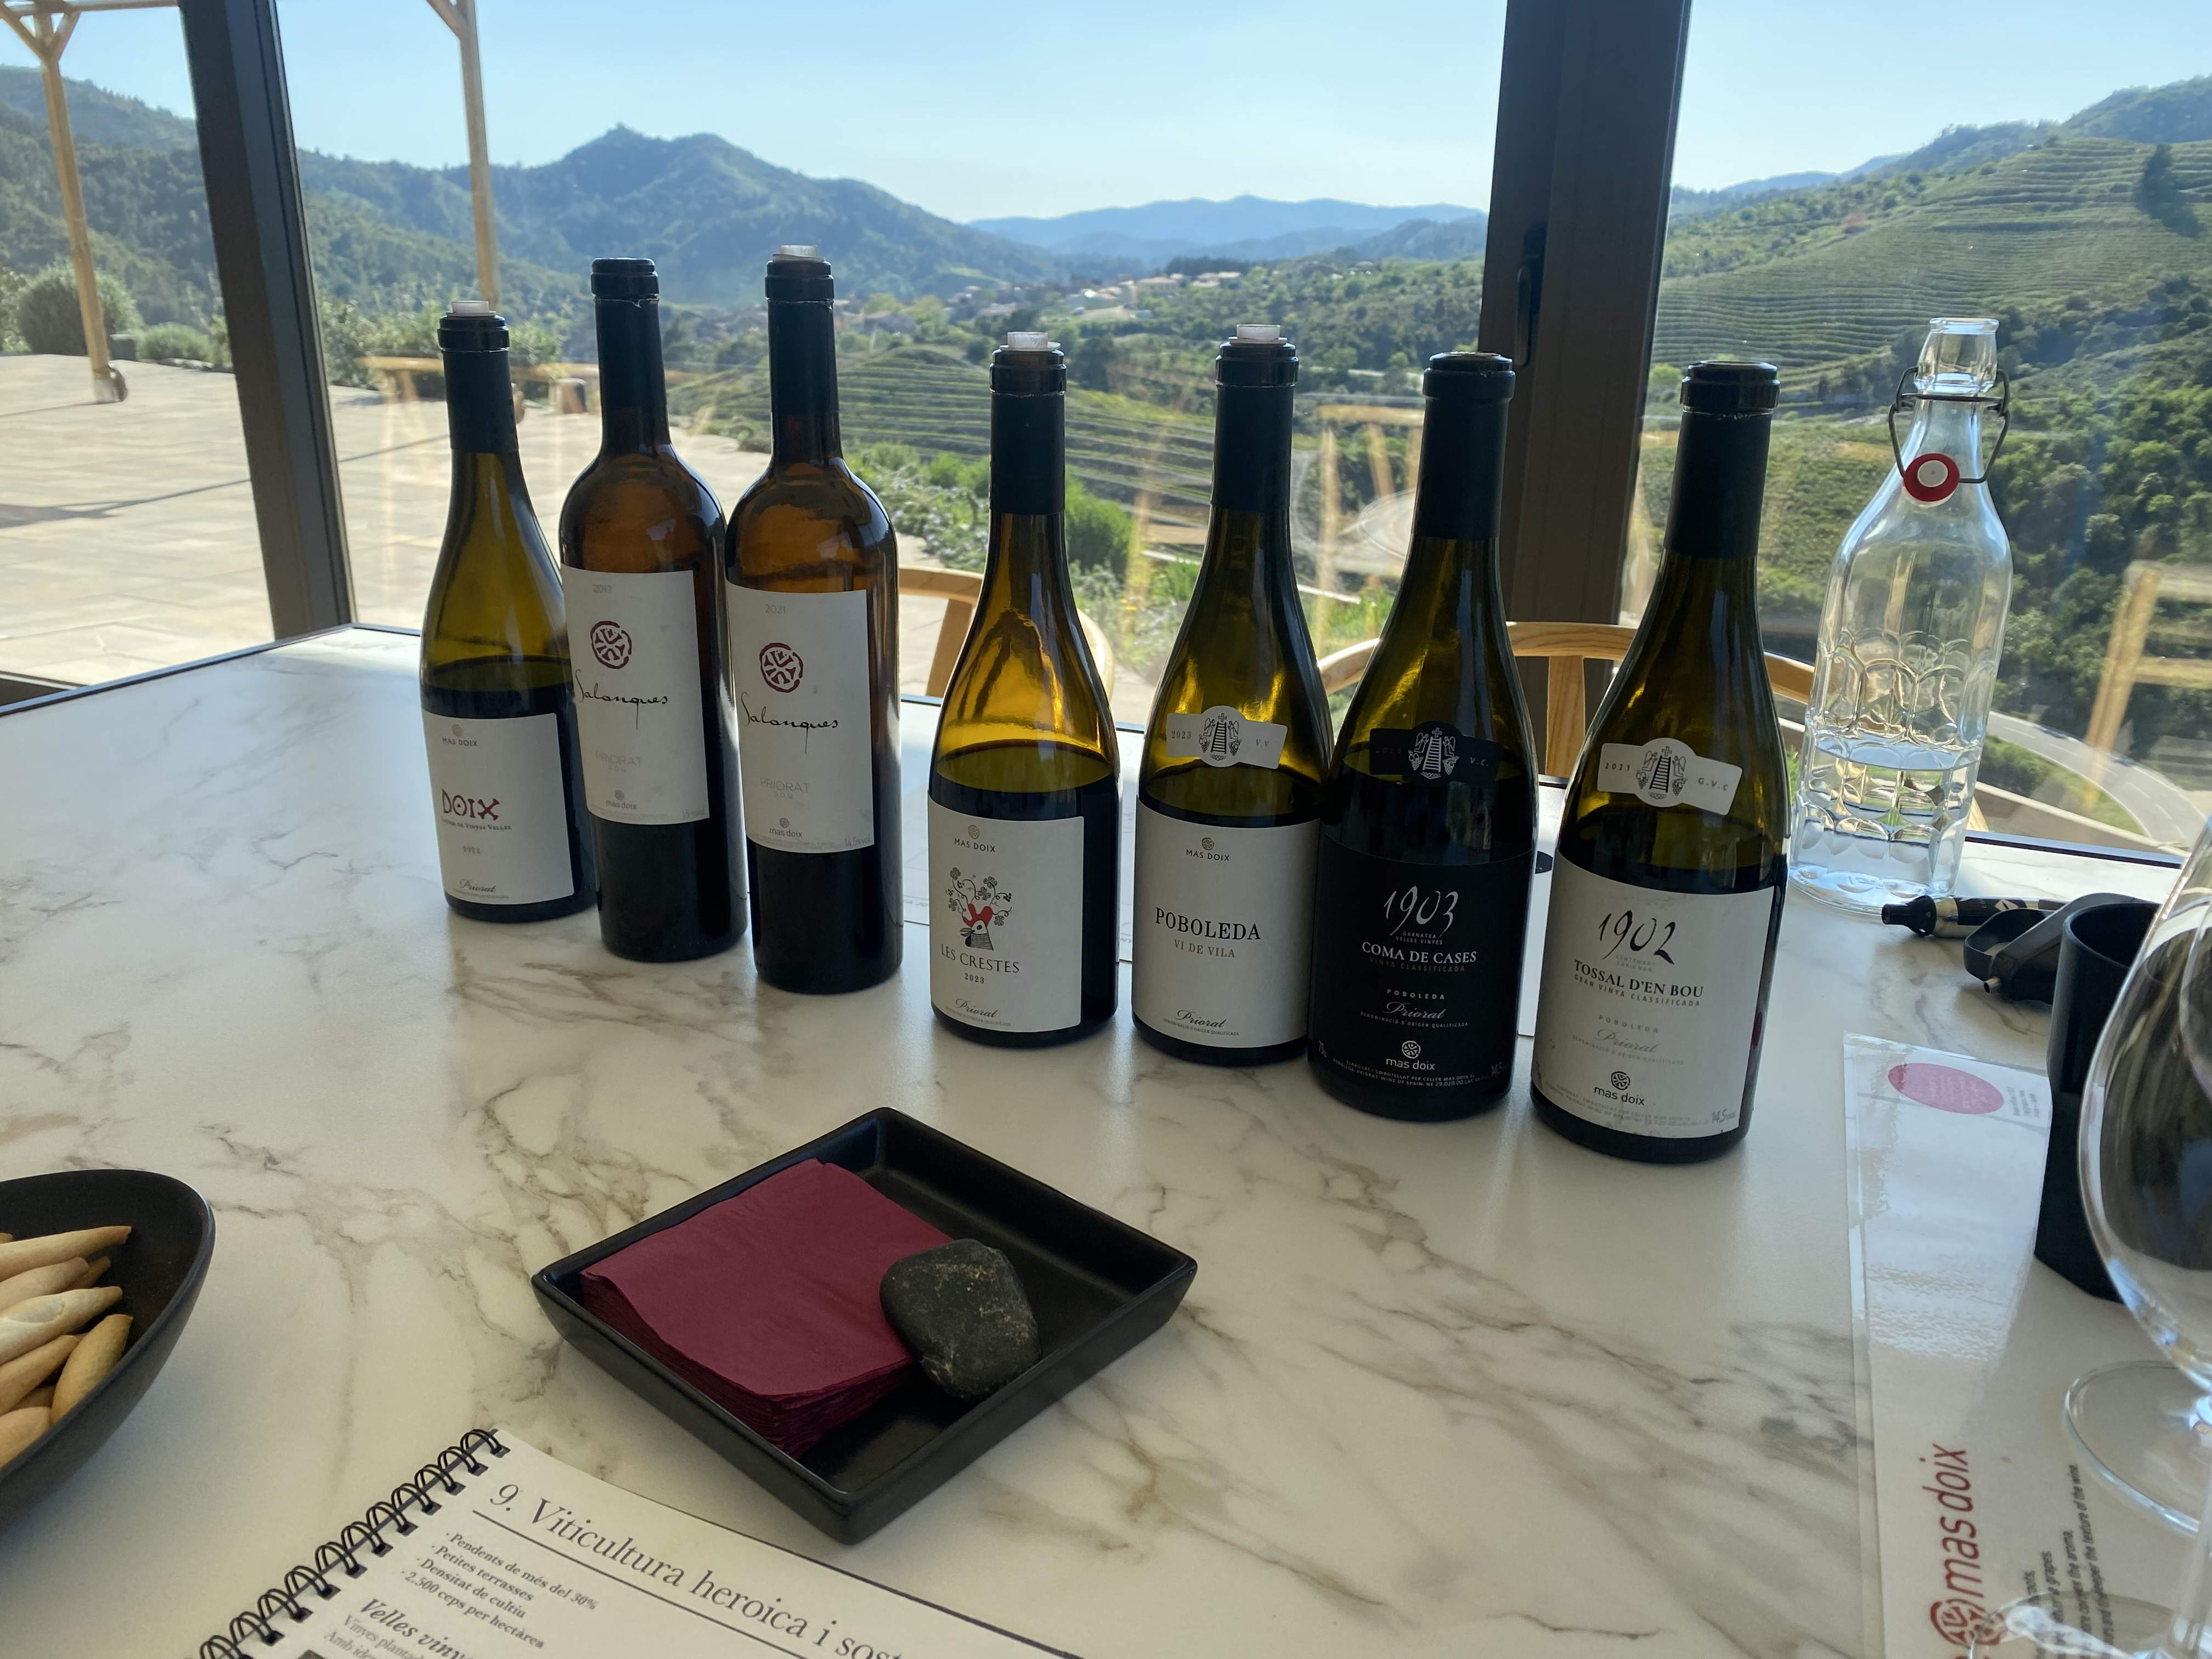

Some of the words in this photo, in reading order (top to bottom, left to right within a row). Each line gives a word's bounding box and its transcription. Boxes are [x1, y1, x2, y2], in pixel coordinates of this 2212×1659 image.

[765, 604, 786, 614] 2021
[575, 669, 668, 729] Salanques
[740, 692, 838, 755] Salanques
[442, 736, 456, 744] MAS
[1171, 731, 1191, 740] 2023
[1604, 763, 1630, 771] 2021
[441, 788, 500, 821] DOIX
[606, 800, 620, 808] mas
[769, 827, 785, 836] mas
[786, 828, 803, 838] doix
[954, 838, 970, 848] MAS
[974, 843, 996, 853] DOIX
[1186, 849, 1204, 859] MAS
[1207, 852, 1229, 862] DOIX
[459, 878, 496, 892] Priorat
[1383, 885, 1459, 937] 1903
[1156, 907, 1261, 940] POBOLEDA
[1396, 935, 1417, 944] VELLES
[1598, 909, 1675, 965] 1902
[941, 944, 956, 961] LES
[960, 952, 1019, 973] CRESTES
[1174, 940, 1184, 950] VI
[1189, 943, 1203, 955] DE
[1208, 946, 1235, 958] VILA
[1362, 942, 1404, 960] COMA
[1409, 951, 1429, 962] DE
[1434, 951, 1477, 964] CASES
[964, 972, 985, 984] 2023
[1574, 959, 1624, 988] TOSSAL
[1629, 978, 1666, 995] D'EN
[1670, 985, 1704, 997] BOU
[1387, 989, 1446, 1000] POBOLEDA
[1574, 974, 1594, 988] GRAN
[1599, 984, 1625, 997] VINYA
[1630, 994, 1700, 1007] CLASSIFICADA
[954, 998, 998, 1018] Priorat
[1175, 1009, 1227, 1028] Priorat
[1383, 1001, 1447, 1019] Priorat
[1599, 1015, 1659, 1033] POBOLEDA
[1593, 1029, 1660, 1053] Priorat
[1386, 1057, 1409, 1069] mas
[1413, 1059, 1435, 1071] doix
[1594, 1086, 1618, 1101] mas
[1621, 1092, 1645, 1106] doix
[1918, 1442, 1976, 1513] doix
[449, 1532, 504, 1567] Pendents
[505, 1562, 521, 1575] de
[521, 1568, 549, 1589] més
[549, 1581, 570, 1599] del
[489, 1482, 520, 1512] 9.
[528, 1497, 685, 1587] Viticultura
[689, 1569, 808, 1639] heroica
[816, 1620, 838, 1647] i
[1937, 1516, 1984, 1598] mas
[436, 1545, 476, 1573] Petites
[477, 1570, 535, 1601] terrasses
[404, 1572, 439, 1594] 2.500
[438, 1591, 465, 1609] ceps
[465, 1605, 489, 1622] per
[420, 1559, 473, 1591] Densitat
[472, 1587, 489, 1600] de
[489, 1594, 526, 1619] cultiu
[343, 1613, 379, 1641] Vinyes
[360, 1599, 419, 1638] Velles
[323, 1632, 352, 1651] Amb
